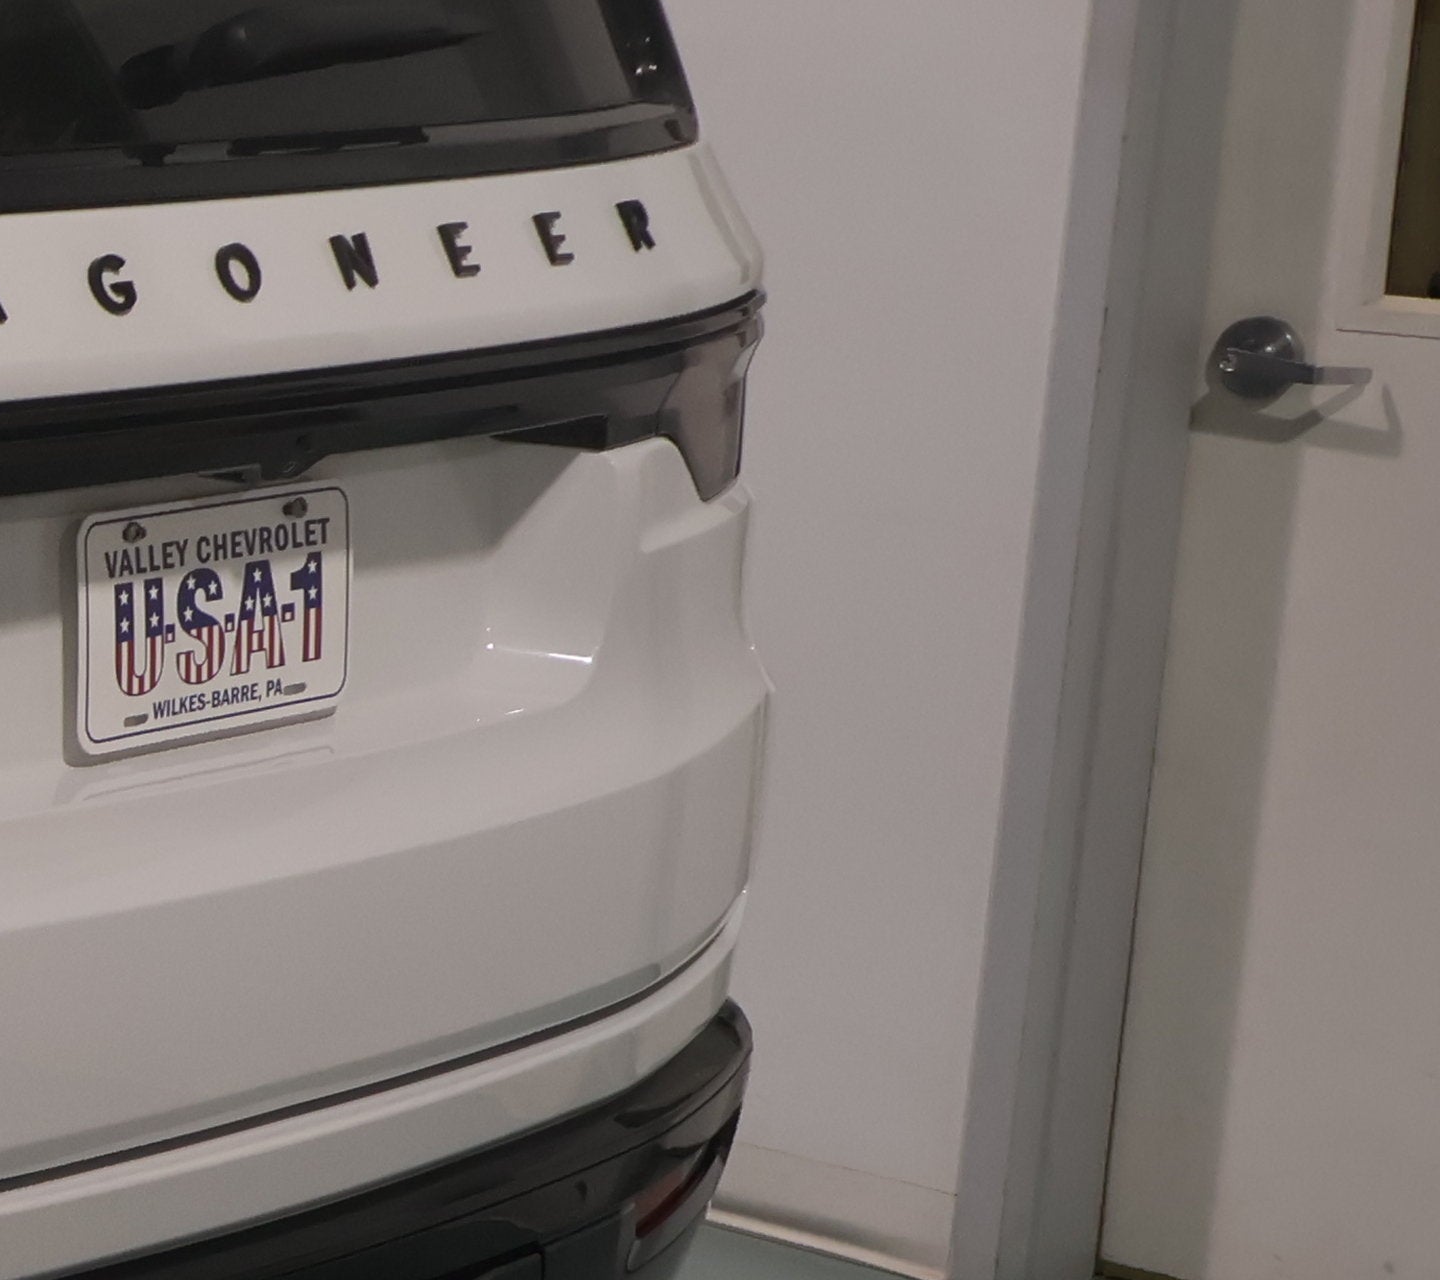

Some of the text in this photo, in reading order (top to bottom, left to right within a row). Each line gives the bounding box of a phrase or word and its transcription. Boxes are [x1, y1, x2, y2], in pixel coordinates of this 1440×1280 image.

[104, 517, 331, 579] VALLEY CHEVROLET
[152, 683, 262, 720] WILKES-BARRE,
